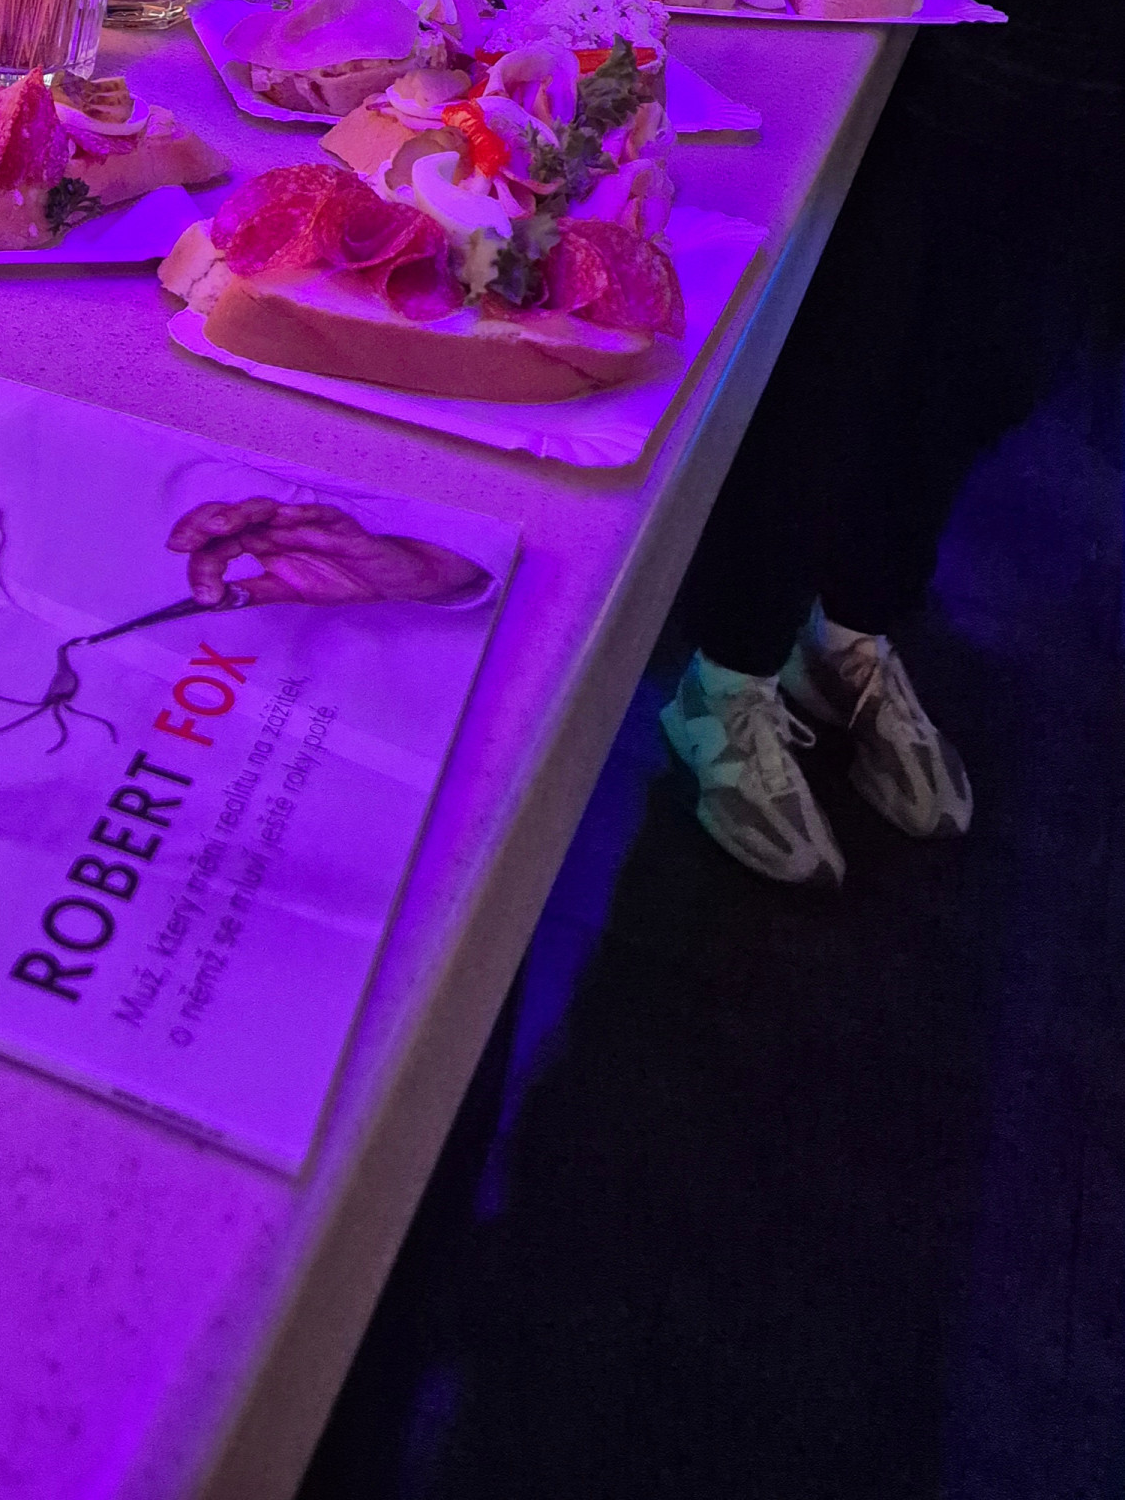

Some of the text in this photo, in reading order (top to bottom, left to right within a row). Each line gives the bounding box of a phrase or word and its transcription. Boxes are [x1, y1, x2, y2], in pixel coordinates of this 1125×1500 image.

[8, 749, 192, 1003] ROBERT
[151, 641, 257, 747] FOX
[168, 1025, 195, 1048] o
[211, 916, 242, 948] se
[281, 750, 323, 793] roky
[214, 768, 261, 834] realitu
[246, 739, 274, 766] na
